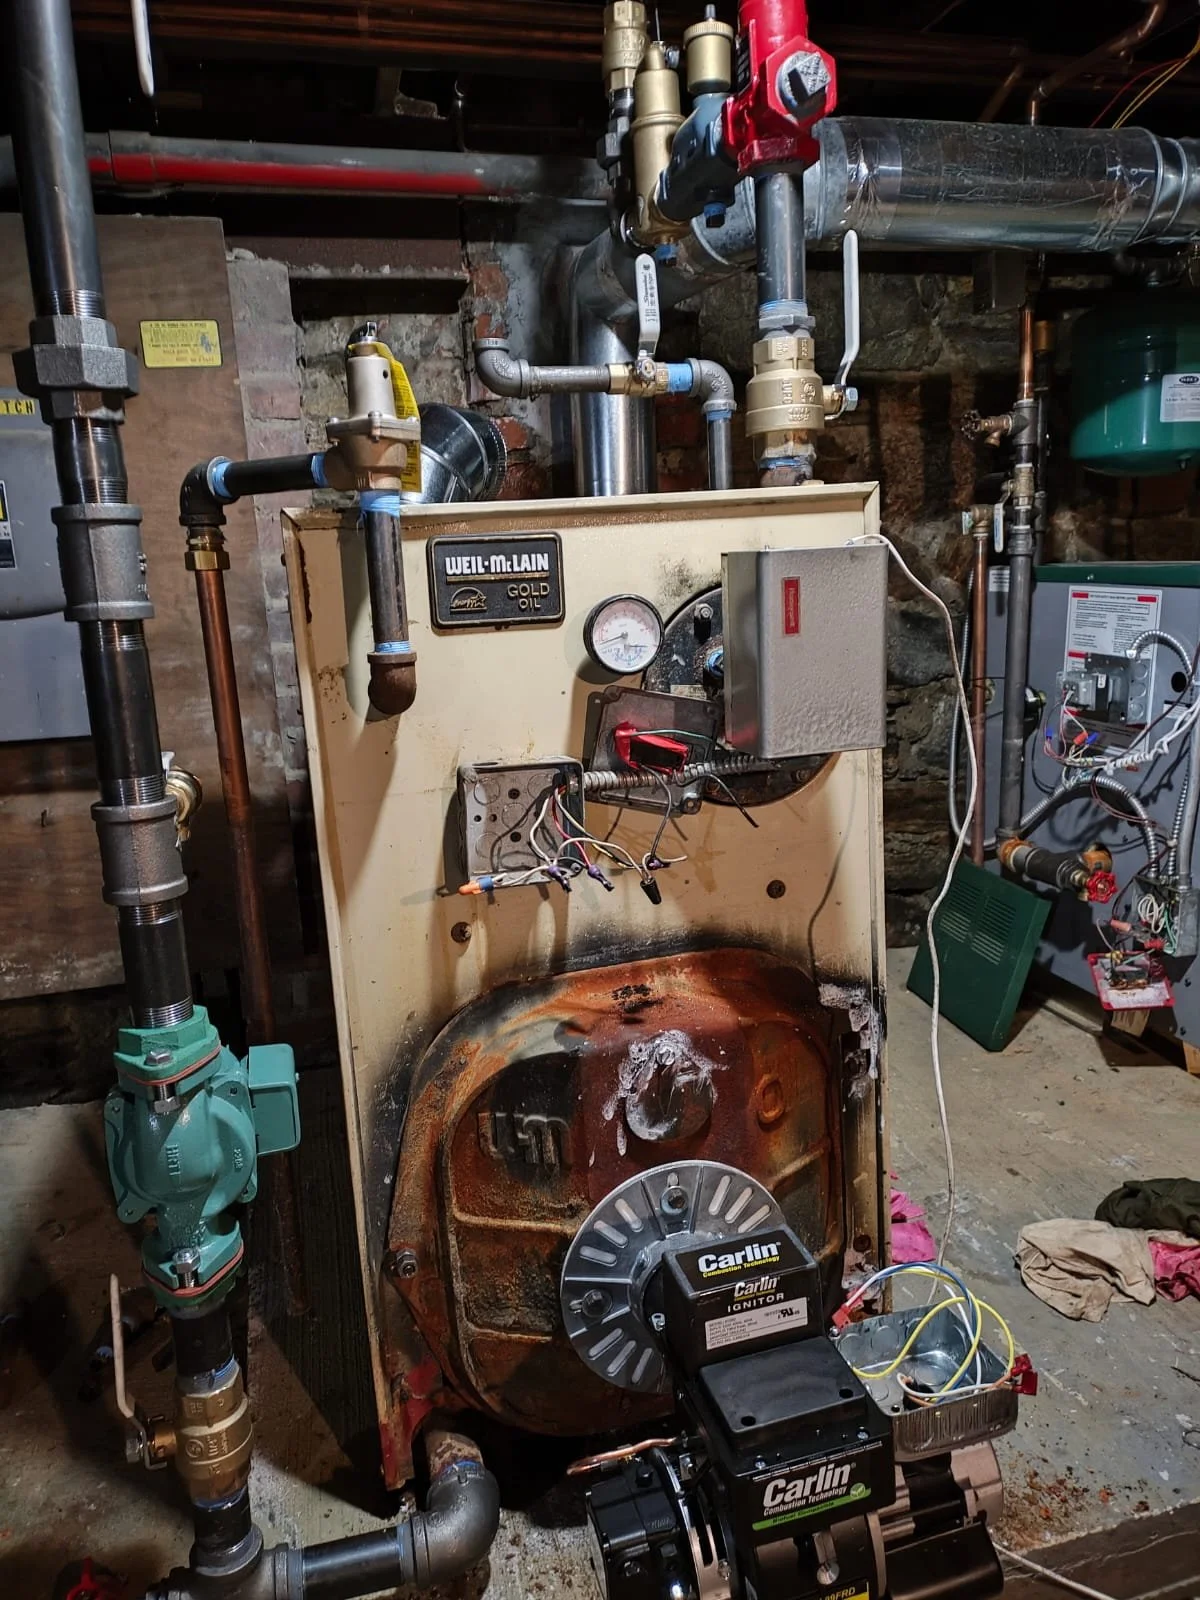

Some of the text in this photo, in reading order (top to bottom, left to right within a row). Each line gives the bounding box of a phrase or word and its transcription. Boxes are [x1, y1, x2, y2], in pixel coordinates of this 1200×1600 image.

[507, 583, 550, 597] GOLD
[519, 598, 541, 609] OIL
[698, 1243, 779, 1273] Carlin
[703, 1255, 780, 1278] Combustion Technology
[734, 1276, 778, 1298] Carlin
[727, 1293, 785, 1313] IGNITOR
[763, 1463, 851, 1508] Carlin
[763, 1486, 848, 1516] Combustion Technology
